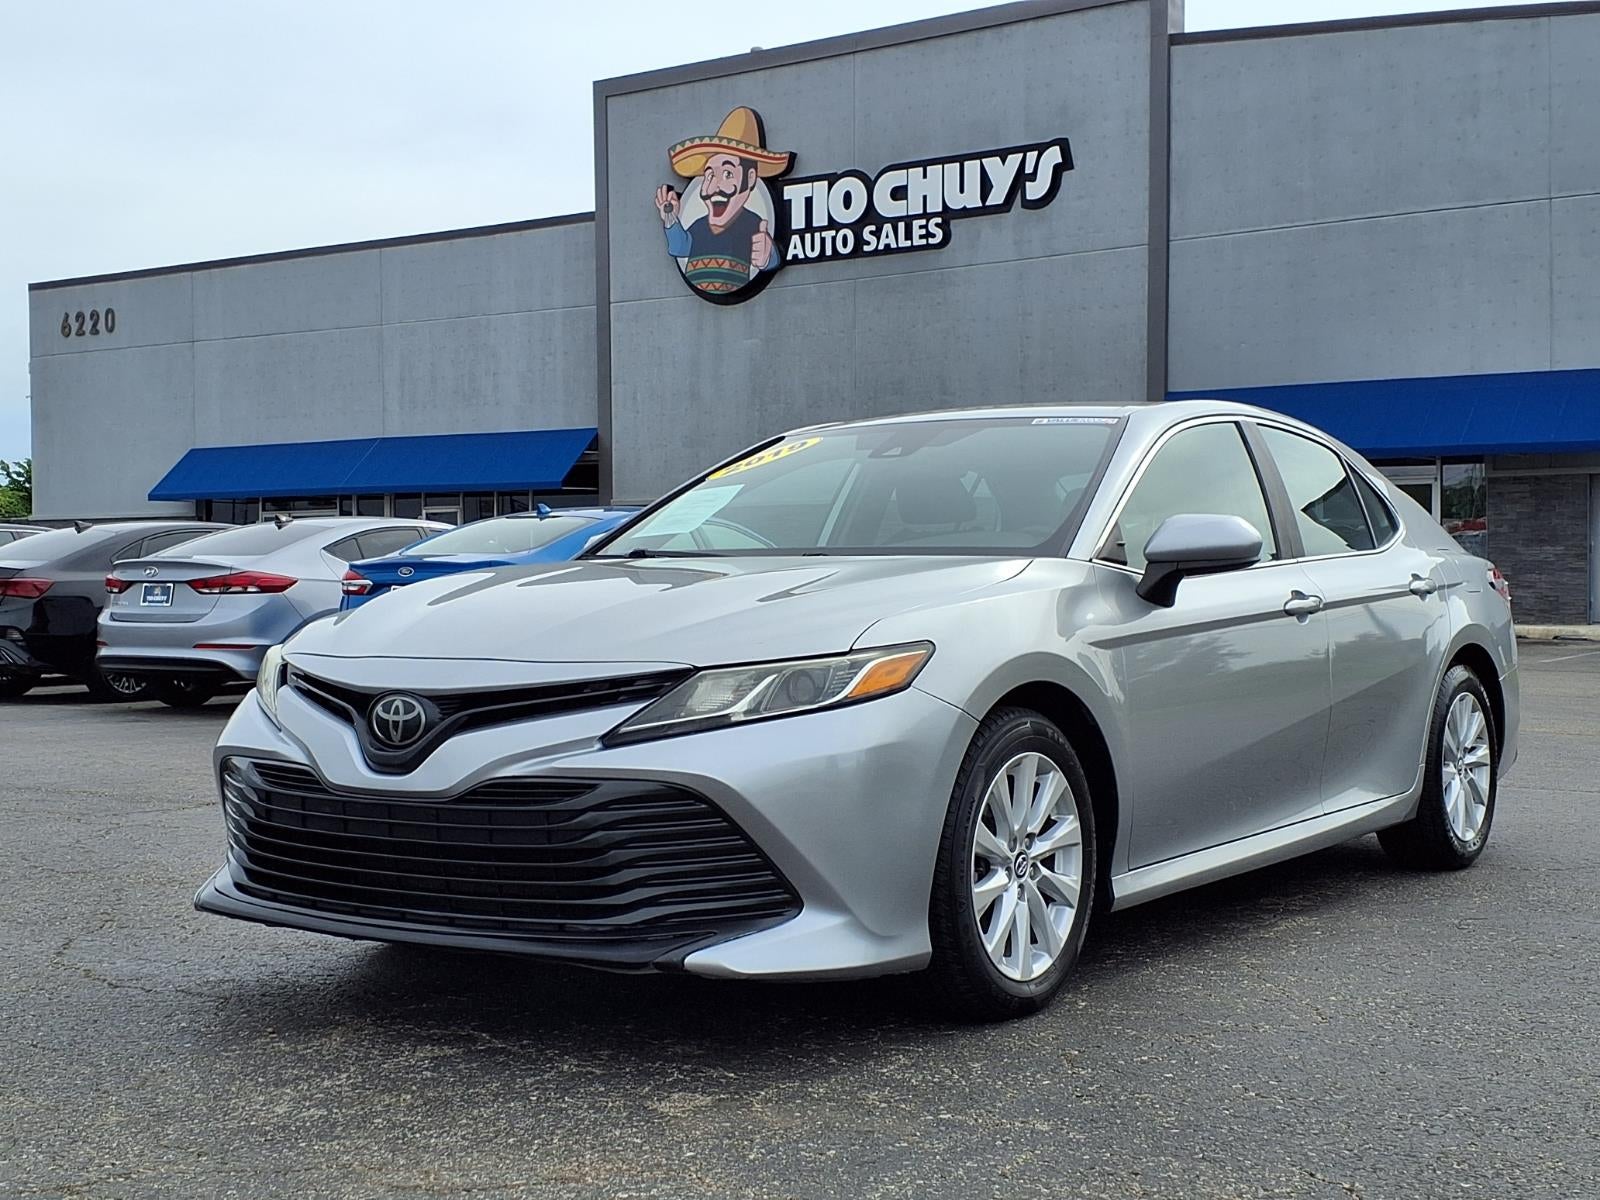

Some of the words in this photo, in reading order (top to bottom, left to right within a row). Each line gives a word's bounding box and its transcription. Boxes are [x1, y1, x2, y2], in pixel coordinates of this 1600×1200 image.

[783, 175, 868, 230] TIO
[872, 145, 1062, 218] CHUY'S
[786, 228, 855, 260] AUTO
[862, 217, 944, 252] SALES
[61, 307, 116, 338] 6220
